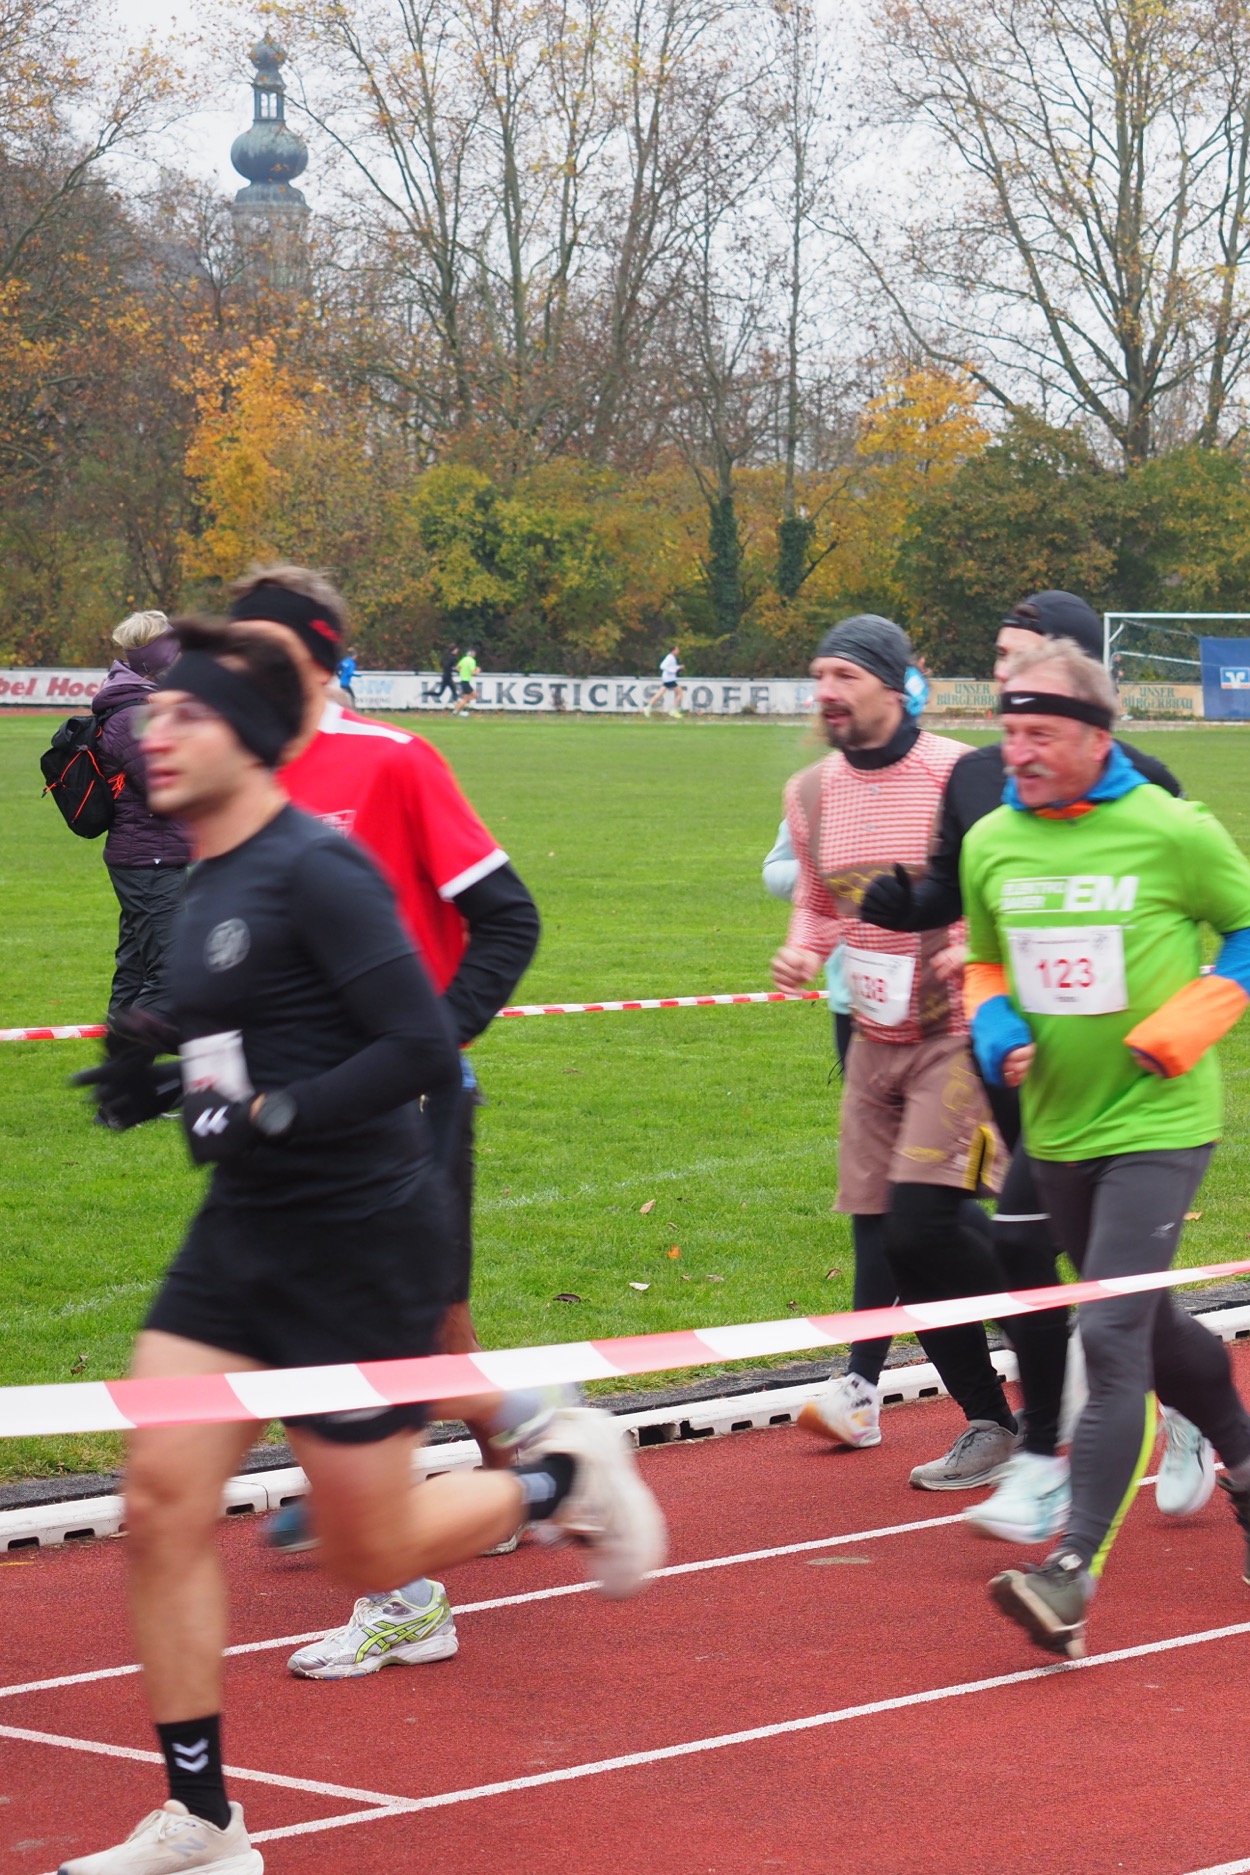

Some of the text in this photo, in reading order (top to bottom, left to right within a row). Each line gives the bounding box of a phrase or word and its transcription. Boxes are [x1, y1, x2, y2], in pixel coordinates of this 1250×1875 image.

[46, 677, 103, 697] Hoc
[955, 683, 990, 694] UNSER
[1140, 687, 1175, 698] UNSER
[937, 692, 1002, 706] BÜRGERBR
[1063, 876, 1139, 911] EM
[1035, 957, 1096, 989] 123
